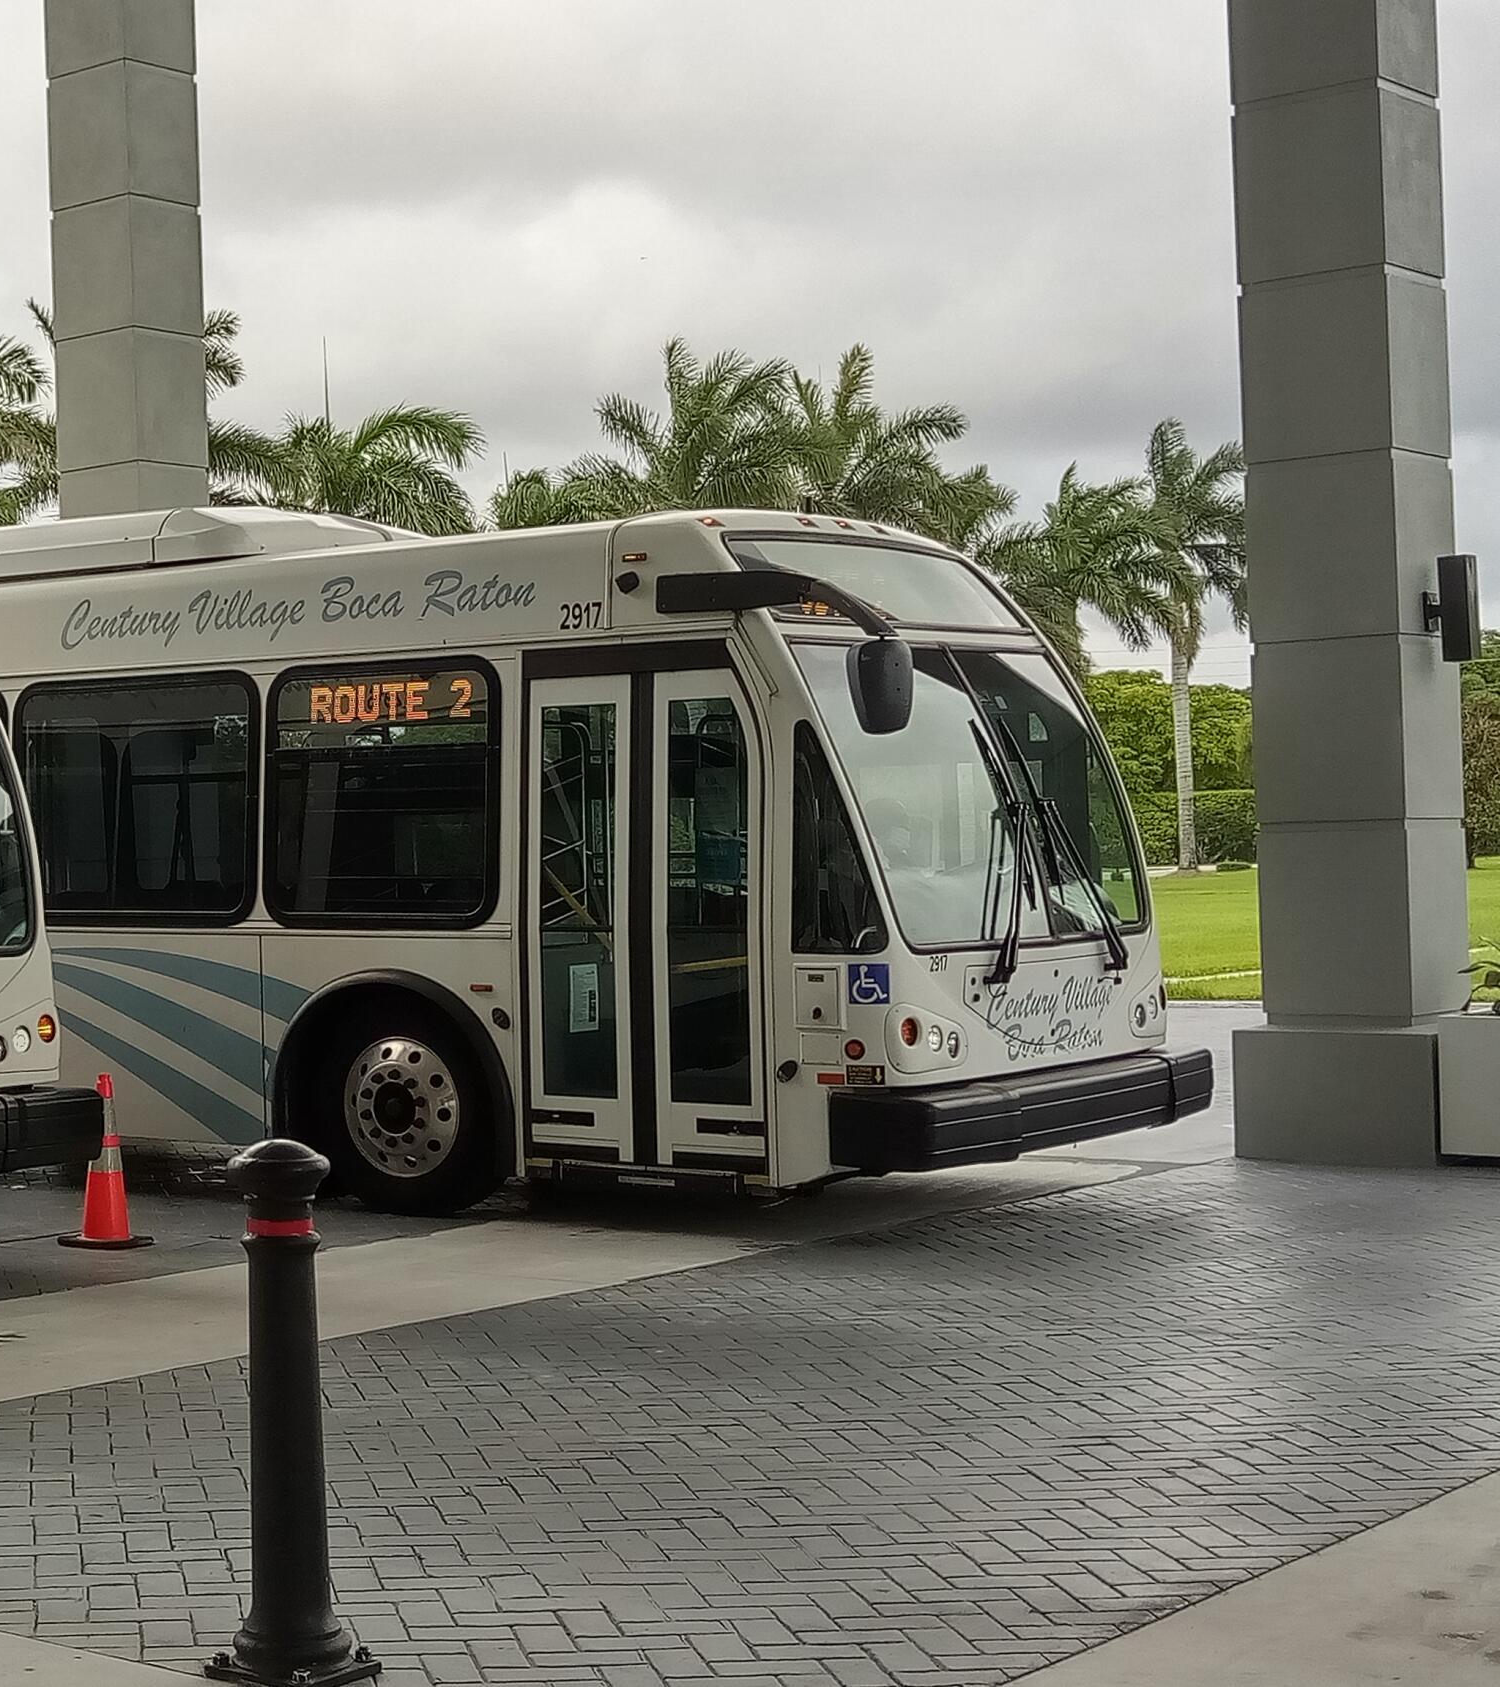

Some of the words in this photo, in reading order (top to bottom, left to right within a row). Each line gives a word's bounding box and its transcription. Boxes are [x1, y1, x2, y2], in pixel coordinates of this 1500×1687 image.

[61, 599, 181, 651] Century
[187, 588, 306, 641] Village
[320, 575, 405, 623] Boca
[417, 569, 537, 622] Raton
[558, 601, 603, 631] 2917
[310, 680, 430, 725] ROUTE
[449, 677, 473, 718] 2
[928, 955, 949, 972] 2917
[987, 984, 1059, 1030] Century
[1063, 975, 1113, 1019] Village
